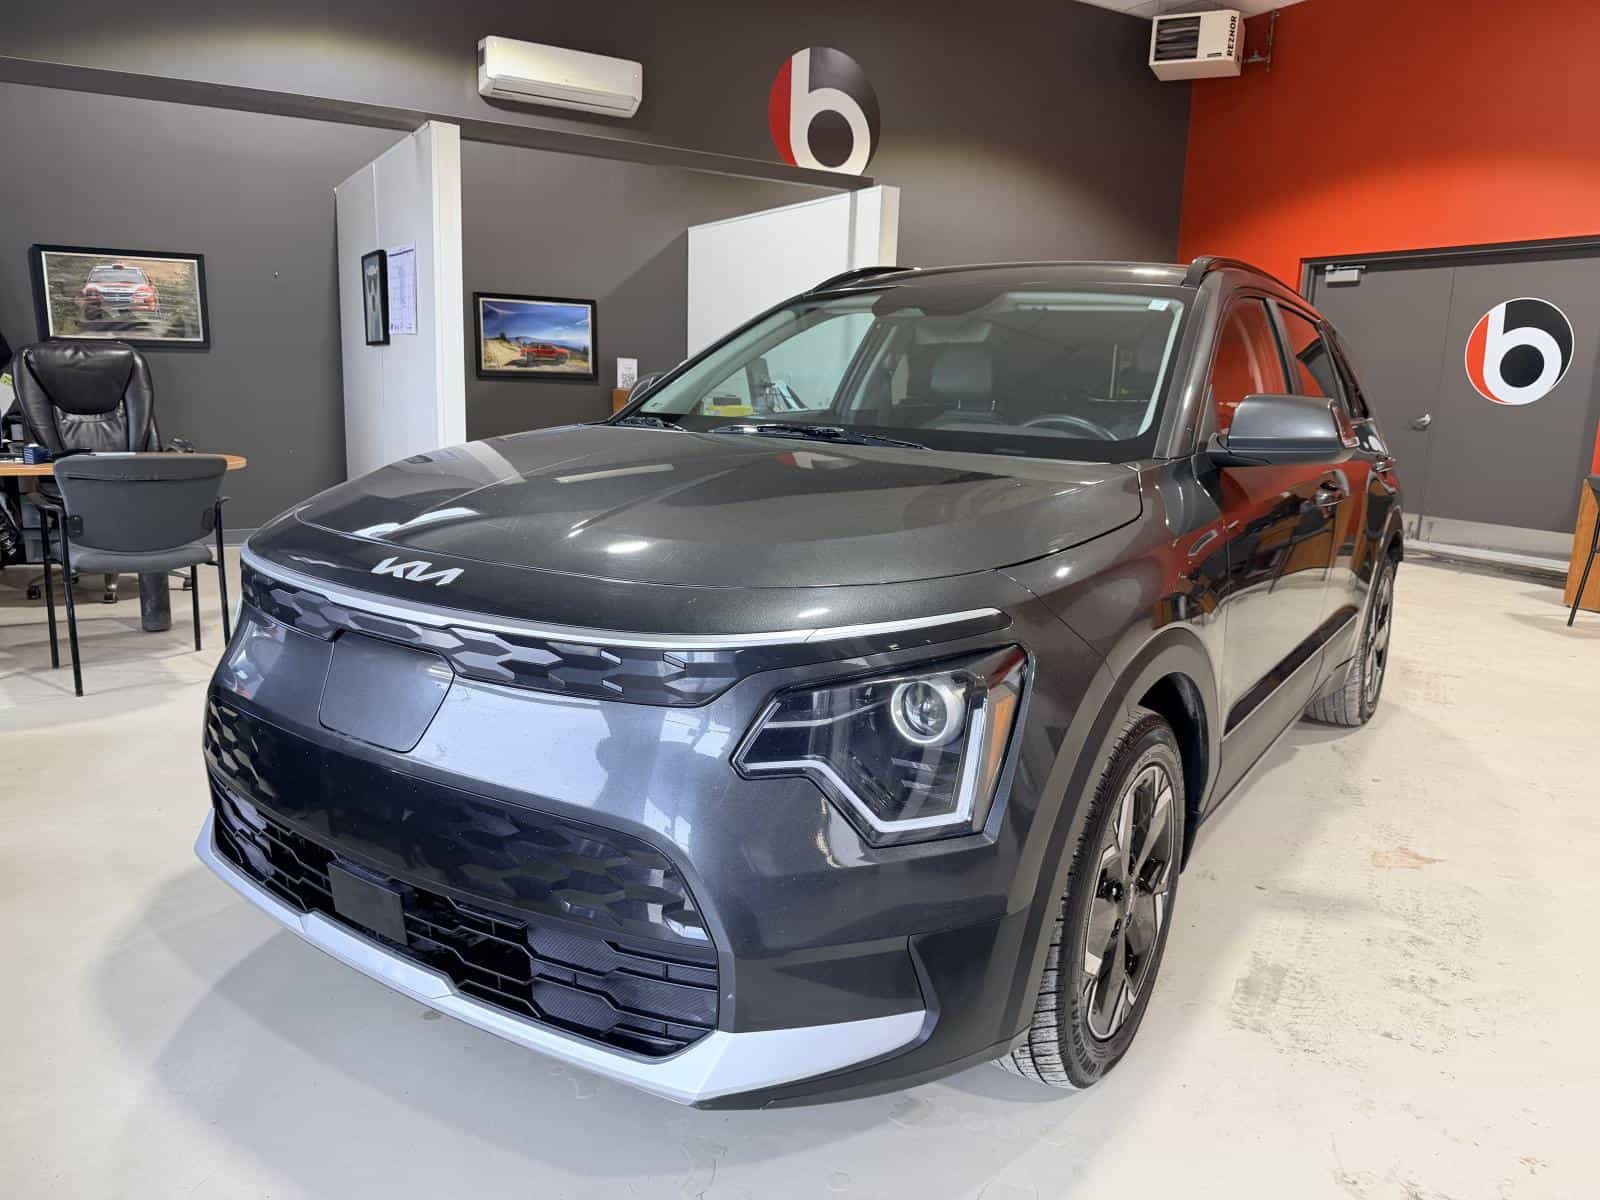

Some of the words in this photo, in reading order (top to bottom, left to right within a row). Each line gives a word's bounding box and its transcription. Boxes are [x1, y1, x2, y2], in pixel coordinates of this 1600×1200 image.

[1226, 15, 1237, 57] REZNOR
[789, 47, 871, 176] b
[1483, 301, 1562, 405] b
[371, 556, 465, 587] KIA
